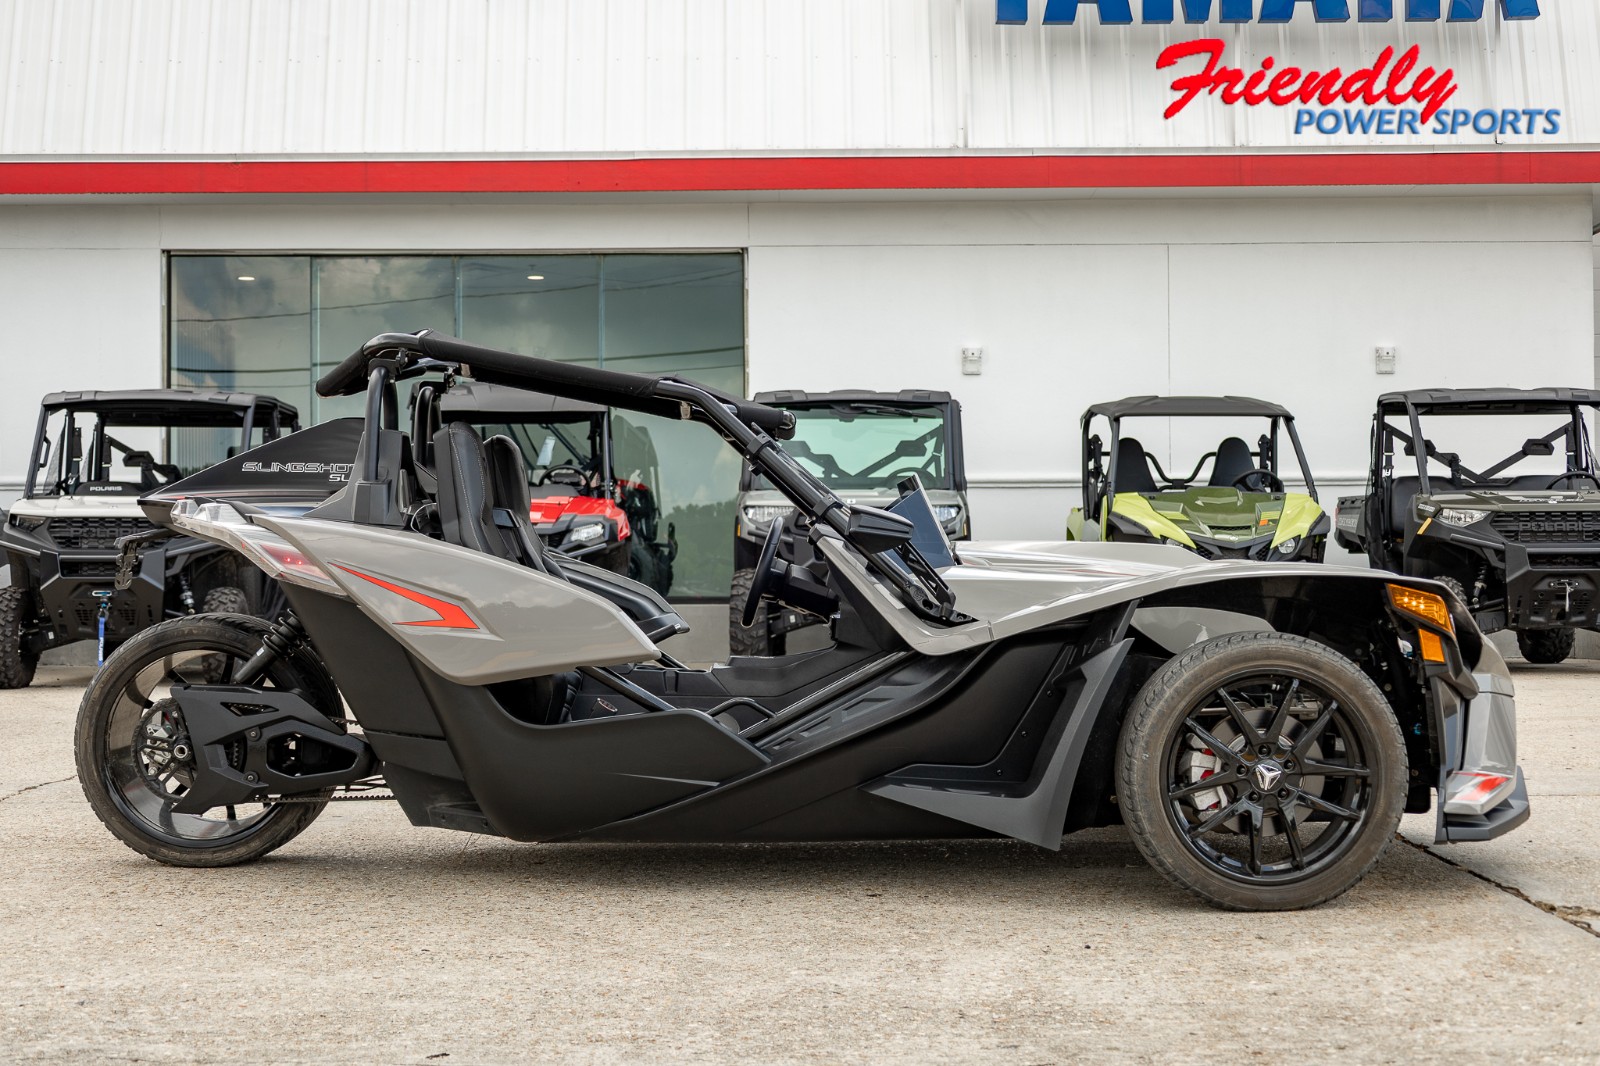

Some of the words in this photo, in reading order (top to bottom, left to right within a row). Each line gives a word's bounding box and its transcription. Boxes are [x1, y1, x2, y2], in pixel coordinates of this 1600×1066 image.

[1156, 38, 1458, 124] Friendly
[1294, 108, 1420, 135] POWER
[1432, 108, 1561, 135] SPORTS
[1519, 521, 1594, 531] POLARIS
